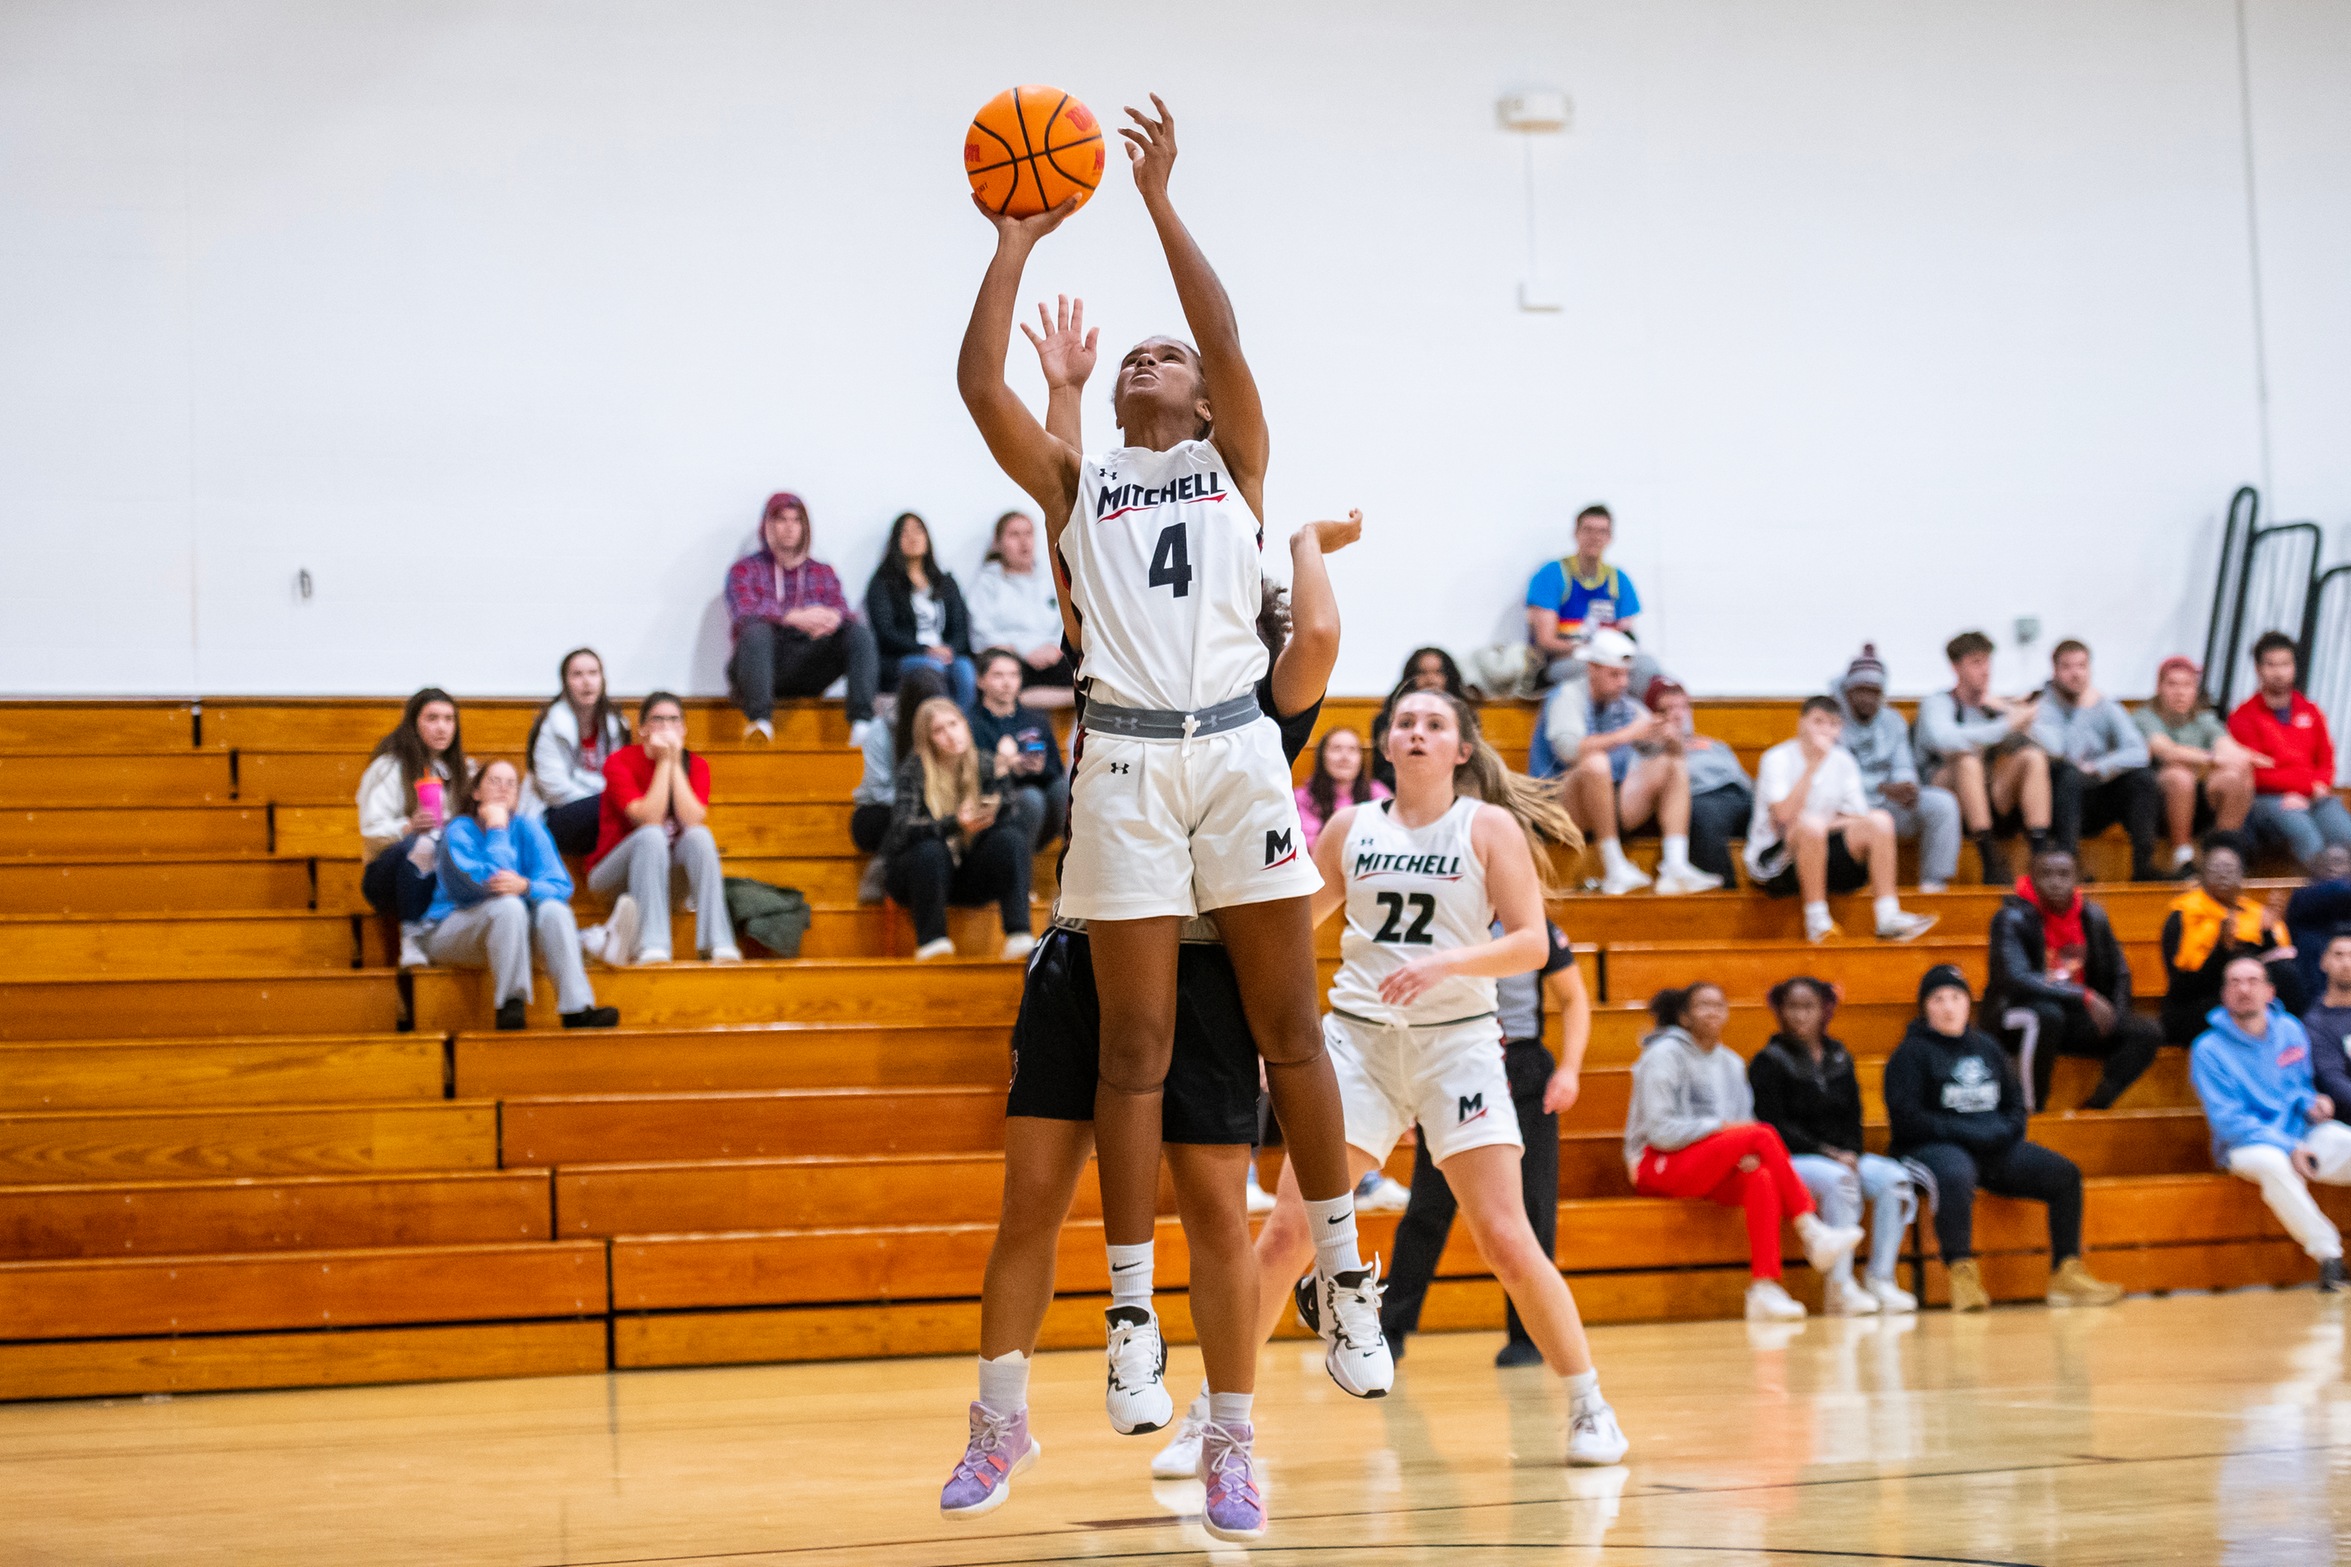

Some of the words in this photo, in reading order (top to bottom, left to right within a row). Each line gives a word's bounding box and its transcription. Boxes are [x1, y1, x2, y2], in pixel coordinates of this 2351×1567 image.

[1097, 472, 1226, 519] MITCHELL
[1149, 522, 1192, 598] 4
[1265, 828, 1293, 866] M
[1355, 853, 1462, 876] MITCHELL
[1373, 892, 1436, 945] 22
[1459, 1093, 1482, 1123] M
